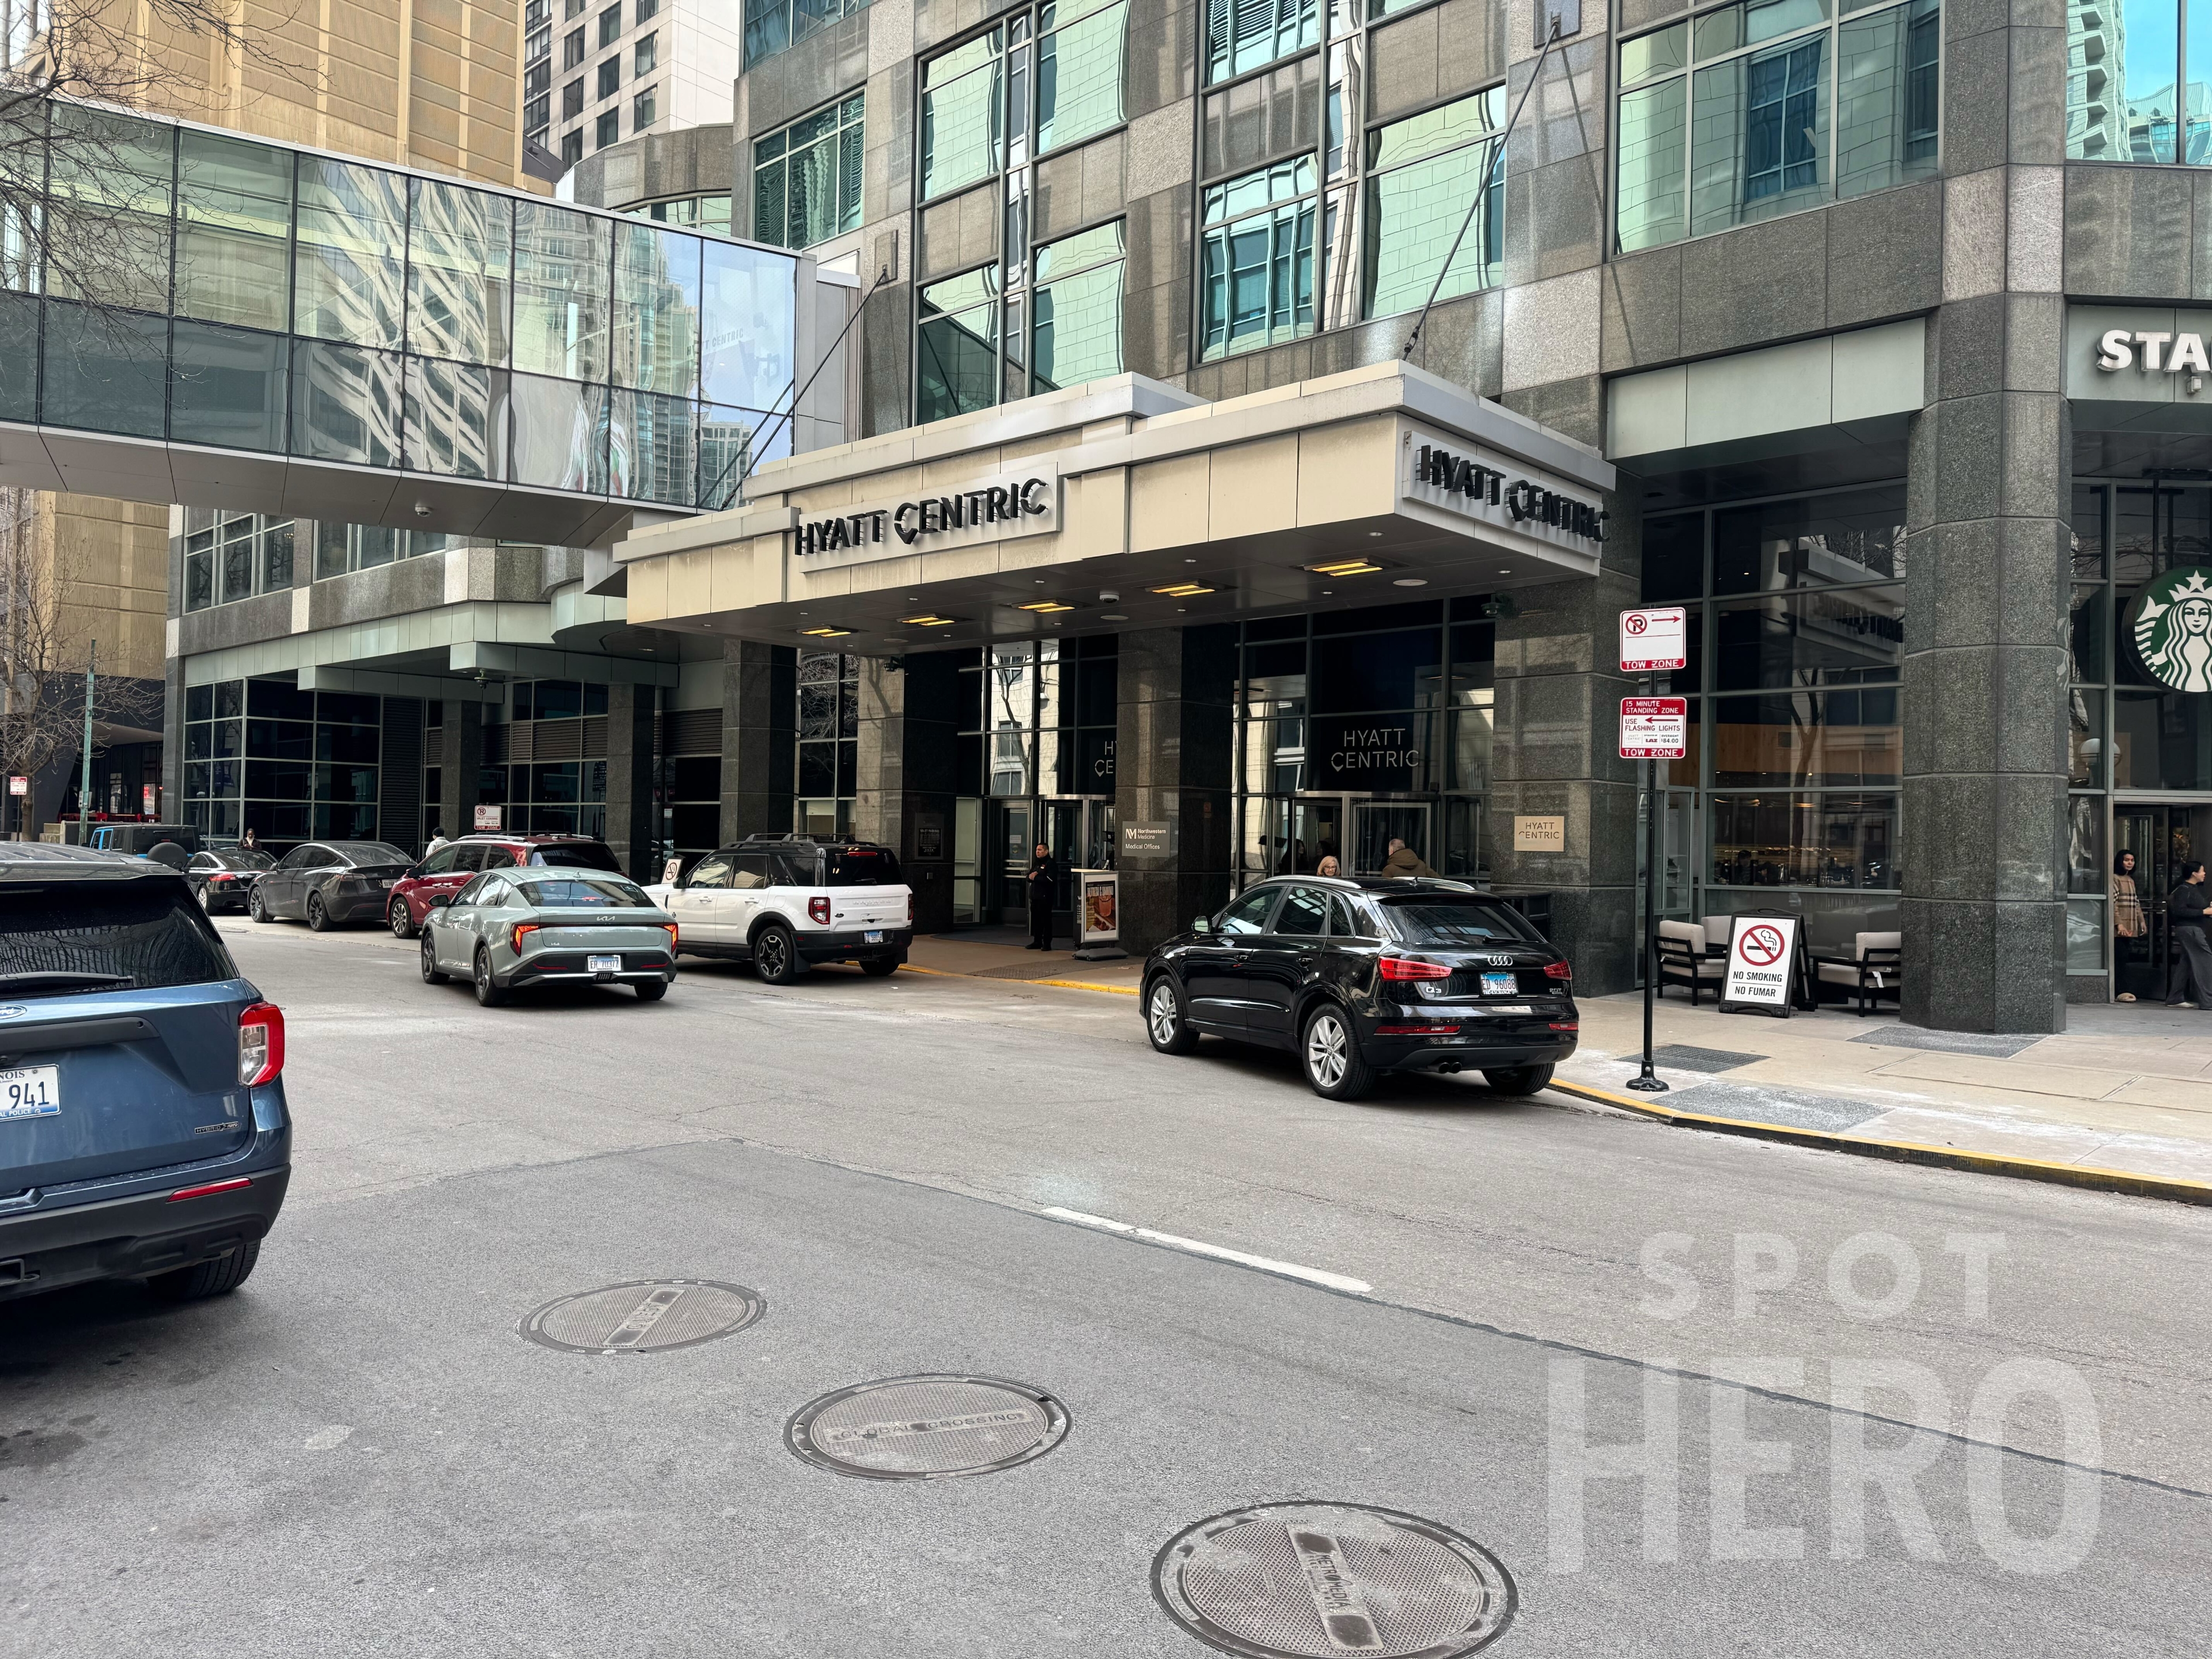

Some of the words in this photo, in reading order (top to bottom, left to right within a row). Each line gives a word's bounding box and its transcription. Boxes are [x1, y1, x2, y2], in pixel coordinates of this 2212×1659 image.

[712, 328, 743, 347] CENTRIC
[2096, 329, 2212, 373] STA
[1421, 445, 1506, 506] HYATT
[1509, 479, 1611, 543] CENTRIC
[794, 509, 888, 556] HYATT
[893, 478, 1047, 545] CENTRIC
[1625, 660, 1646, 669] TOW
[1652, 659, 1679, 668] ZONE
[1344, 728, 1406, 747] HYATT
[1105, 741, 1116, 755] H
[1624, 748, 1646, 756] TOW
[1651, 748, 1679, 756] ZONE
[1095, 759, 1113, 777] CE
[1331, 750, 1419, 772] CENTRIC
[1519, 831, 1560, 839] CENTRIC
[601, 960, 619, 968] 70377
[1481, 979, 1491, 990] ED
[1494, 978, 1516, 990] 96088
[1733, 971, 1744, 980] NO
[1747, 972, 1782, 982] SMOKING
[1735, 986, 1746, 995] NO
[1748, 987, 1776, 997] FUMAR
[8, 1081, 50, 1109] 941
[9, 1108, 32, 1116] POLICE
[927, 1413, 1018, 1430] CROSSING
